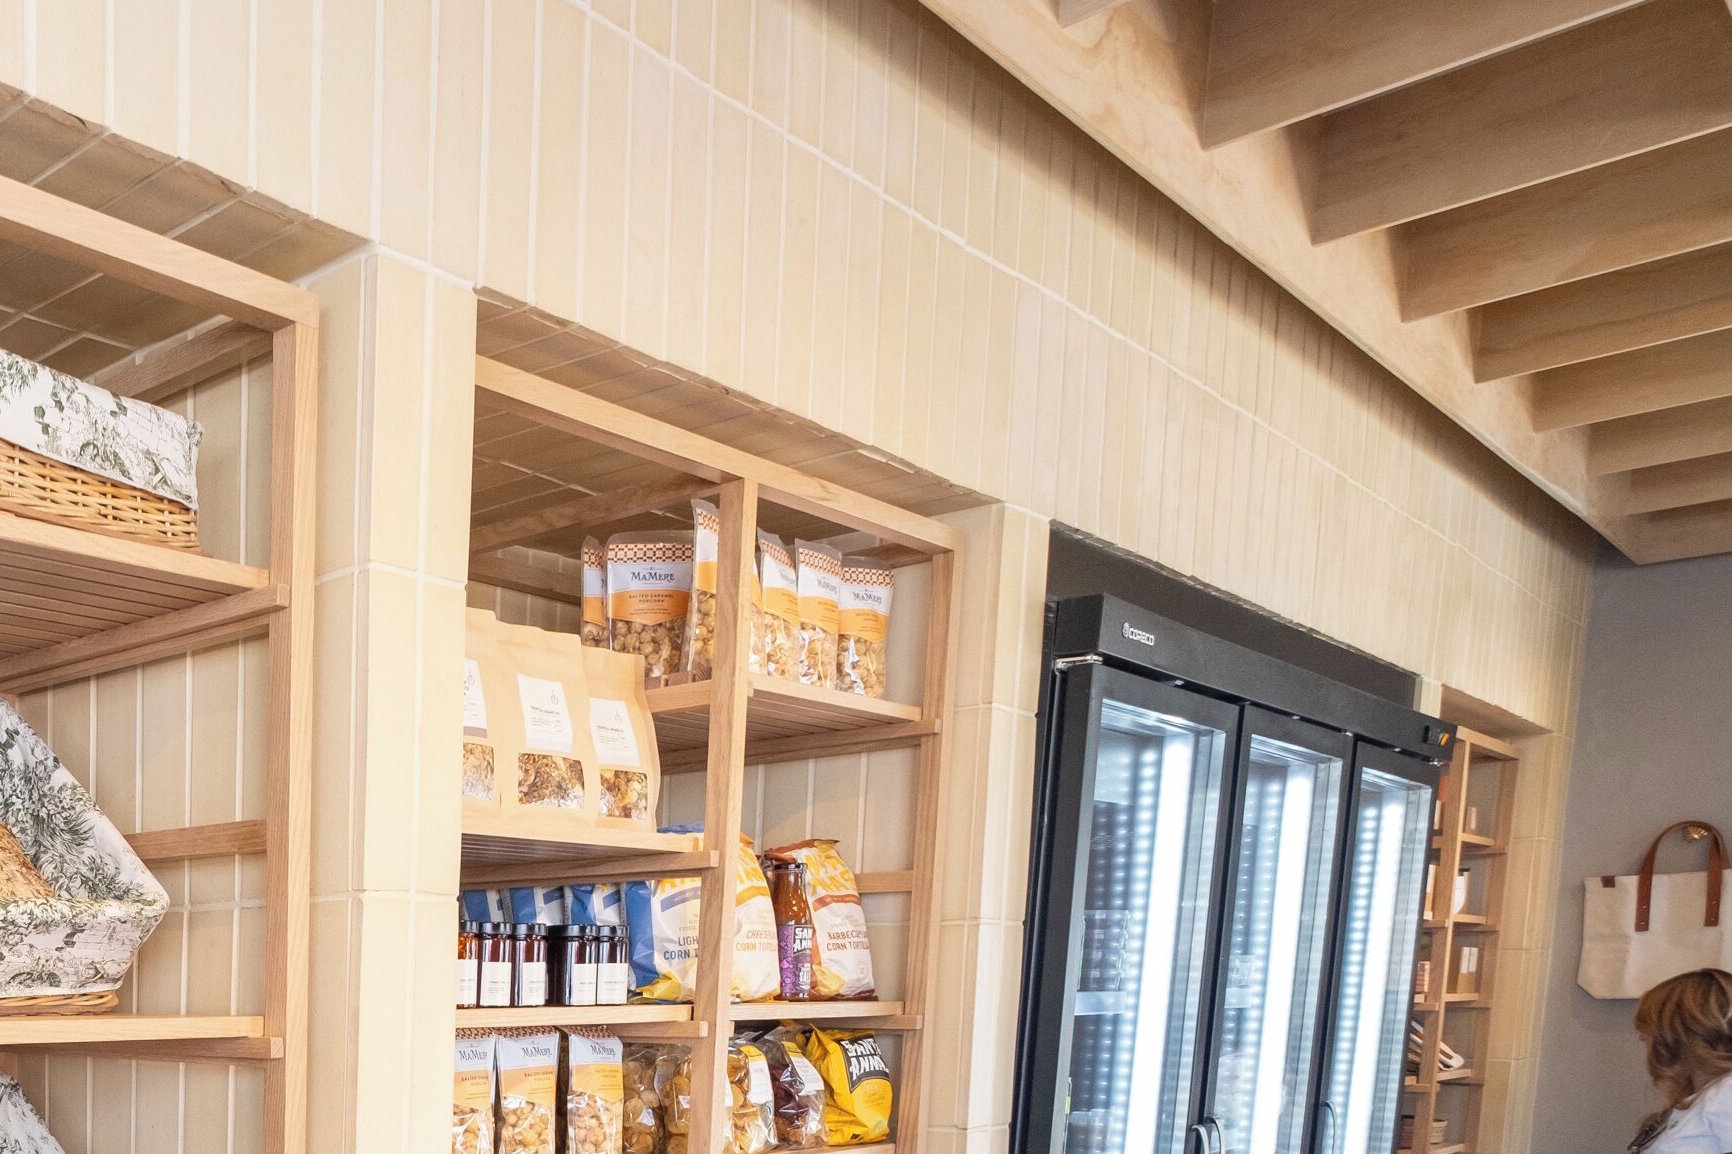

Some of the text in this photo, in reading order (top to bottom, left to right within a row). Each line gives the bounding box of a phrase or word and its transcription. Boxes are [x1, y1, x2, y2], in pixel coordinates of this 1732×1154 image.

[736, 943, 756, 951] CORN
[827, 942, 847, 951] CORN
[664, 949, 690, 960] CORN
